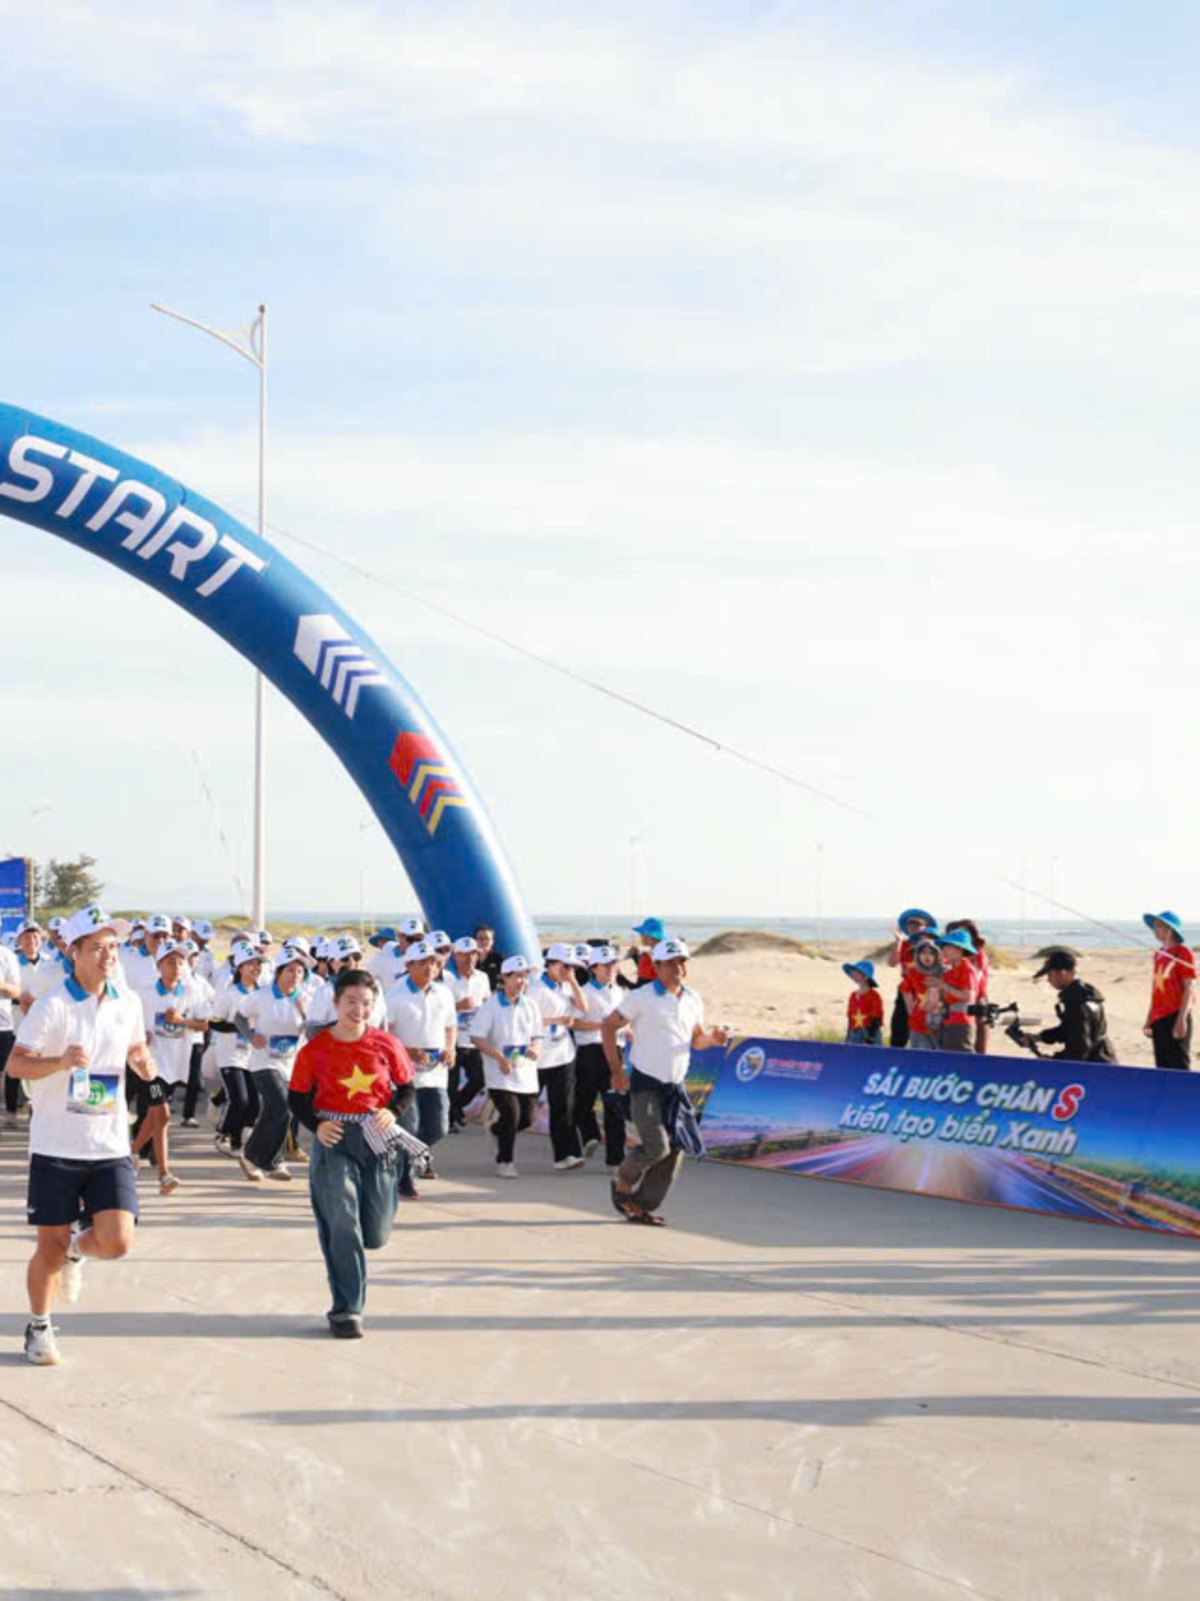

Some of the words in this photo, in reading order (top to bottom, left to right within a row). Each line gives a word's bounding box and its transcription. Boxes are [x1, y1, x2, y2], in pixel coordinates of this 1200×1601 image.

[902, 1072, 974, 1105] BƯỚC
[976, 1080, 1056, 1113] CHÂN
[1051, 1083, 1086, 1121] S
[839, 1102, 890, 1131] kiến
[893, 1109, 936, 1140] tạo
[940, 1108, 998, 1144] biển
[999, 1121, 1078, 1156] Xanh
